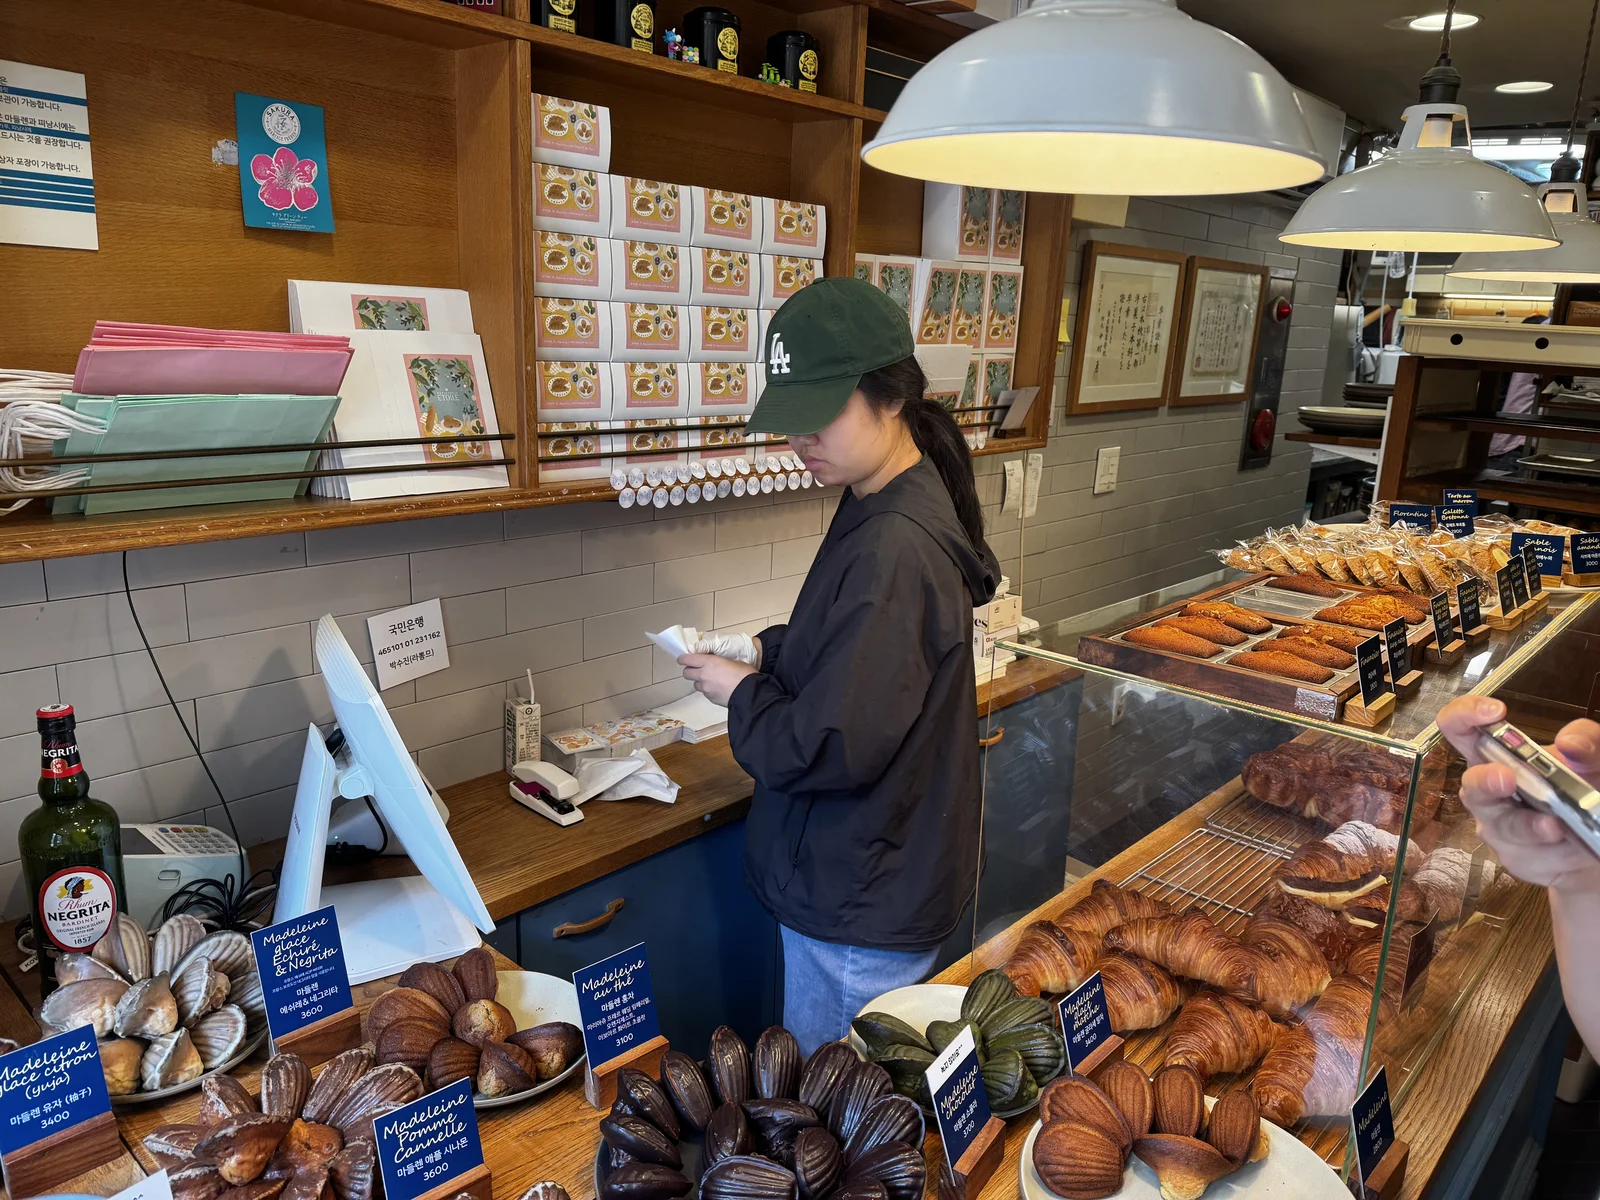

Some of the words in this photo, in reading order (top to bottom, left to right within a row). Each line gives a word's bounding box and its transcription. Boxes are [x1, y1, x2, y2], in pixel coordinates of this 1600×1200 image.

[21, 97, 63, 112] 가능합니다.
[266, 106, 294, 120] SAKURA
[4, 114, 36, 126] 마들렌과
[38, 118, 76, 132] 피낭시에는
[1, 132, 24, 142] 드시는
[26, 134, 41, 144] 것을
[44, 137, 83, 150] 권장합니다.
[16, 157, 39, 168] 포장이
[41, 160, 81, 172] 가능합니다.
[770, 332, 790, 374] LA
[1393, 510, 1428, 518] Florentins
[1580, 536, 1600, 544] Sable
[389, 616, 424, 635] 국민은행
[47, 901, 110, 921] NEGRITA
[58, 898, 97, 910] Rhum
[62, 916, 98, 927] BARDINET
[264, 917, 328, 946] Madeleine
[74, 936, 92, 944] 1857
[274, 935, 310, 956] glace
[273, 940, 320, 966] Echiré
[275, 965, 288, 977] &
[288, 948, 338, 972] Negrita
[582, 960, 645, 994] Madeleine
[594, 987, 612, 1000] au
[614, 974, 634, 992] thé
[296, 982, 319, 996] 마들렌
[310, 985, 338, 1002] 네그리타
[601, 997, 621, 1011] 마들렌
[622, 991, 634, 1003] 홍차
[1065, 983, 1101, 1018] Madeleine
[301, 1005, 323, 1019] 3600
[616, 1033, 634, 1046] 3100
[44, 1050, 97, 1076] citron
[25, 1072, 70, 1100] (yuja)
[941, 1064, 978, 1114] Madeleine
[10, 1107, 41, 1126] 마들렌
[43, 1098, 63, 1114] 유자
[65, 1086, 92, 1105] (柚子)
[946, 1077, 976, 1120] chocolat
[41, 1111, 70, 1129] 3400
[384, 1094, 468, 1140] Madeleine
[1358, 1091, 1388, 1135] Madeleine
[398, 1114, 458, 1147] Pomme
[963, 1120, 975, 1138] 3700
[394, 1122, 467, 1163] Cannelle
[397, 1157, 424, 1177] 마들렌
[425, 1149, 442, 1164] 애플
[444, 1137, 468, 1155] 시나몬
[423, 1162, 449, 1181] 3600
